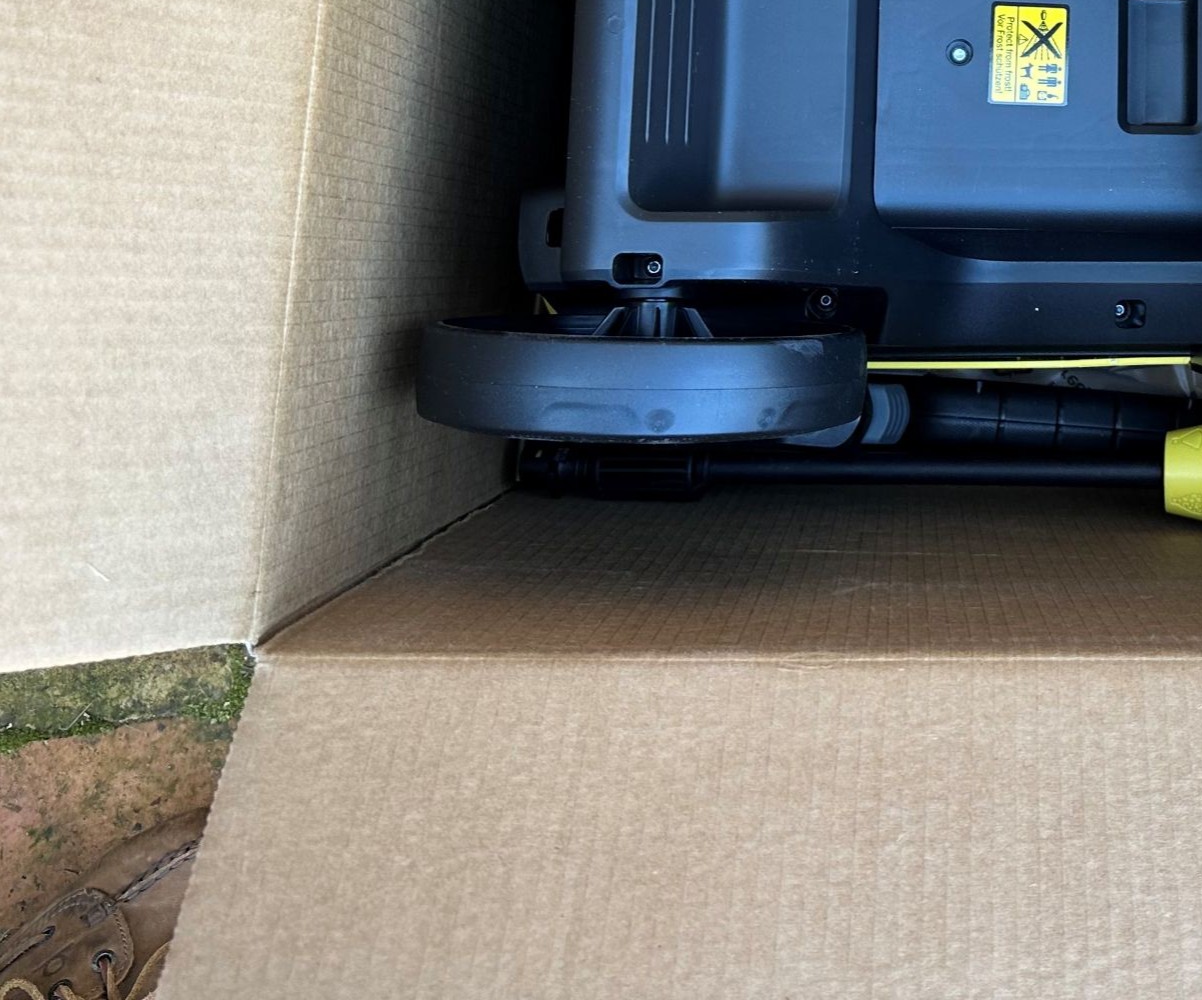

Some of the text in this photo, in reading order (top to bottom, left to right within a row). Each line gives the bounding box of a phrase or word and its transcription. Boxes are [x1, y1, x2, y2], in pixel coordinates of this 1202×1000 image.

[997, 13, 1006, 28] Vor
[996, 30, 1006, 51] Frost
[1004, 16, 1015, 92] Protect from frost!
